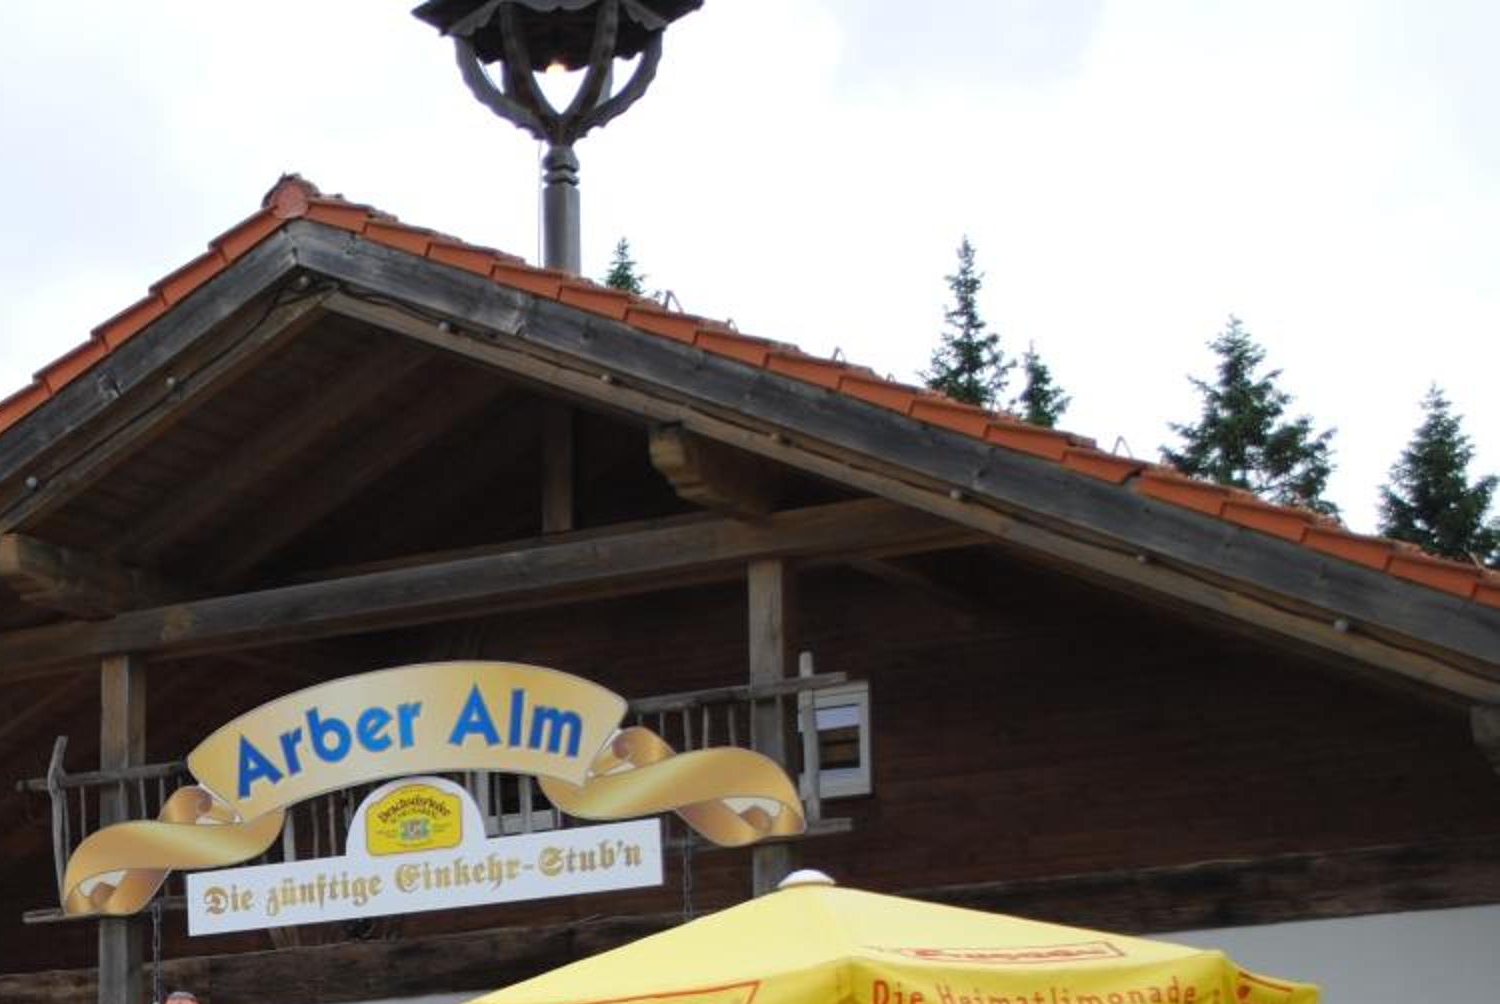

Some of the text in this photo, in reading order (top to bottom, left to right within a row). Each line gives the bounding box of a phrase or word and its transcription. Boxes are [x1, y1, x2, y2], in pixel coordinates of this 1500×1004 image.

[238, 682, 583, 799] Arber Alm
[204, 884, 256, 915] Die
[265, 870, 382, 917] zünftige
